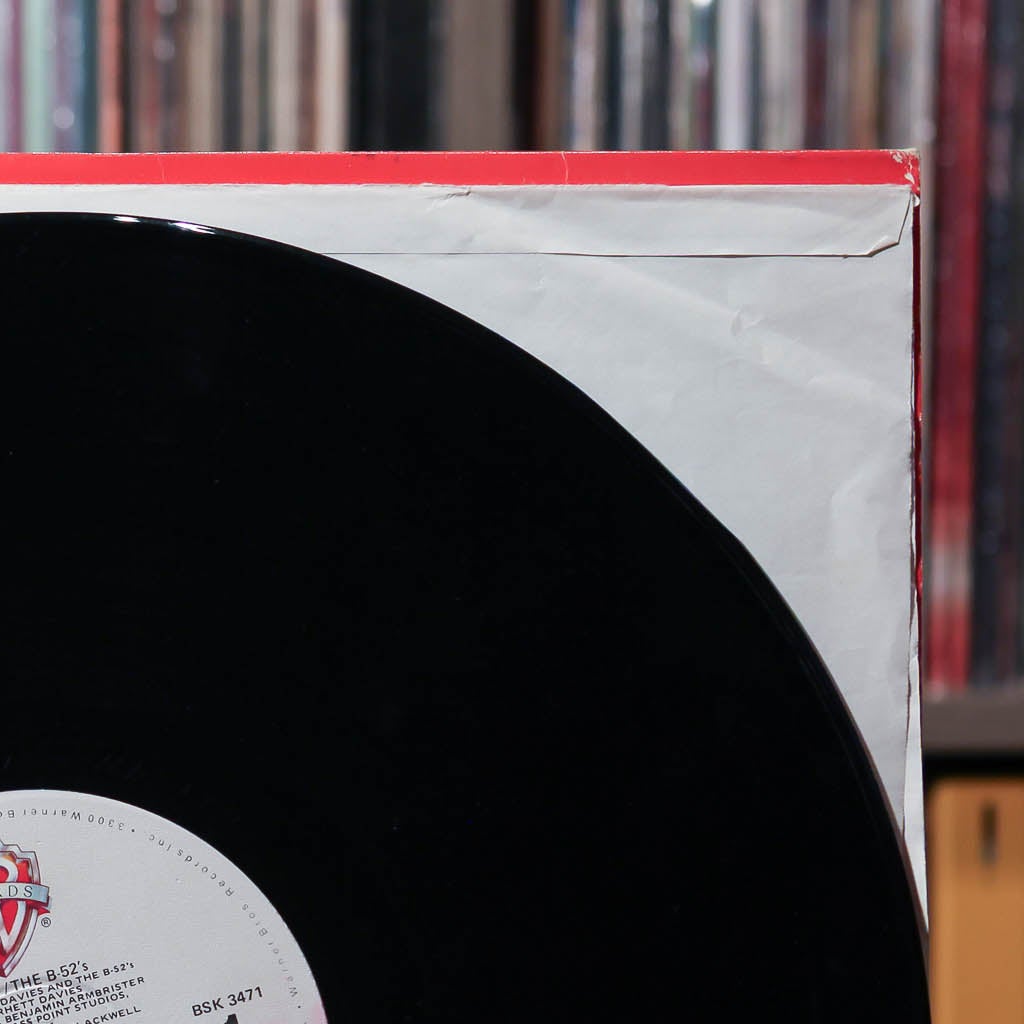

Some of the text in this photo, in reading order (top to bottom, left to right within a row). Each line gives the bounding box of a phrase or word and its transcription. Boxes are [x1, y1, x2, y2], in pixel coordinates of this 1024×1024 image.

[38, 984, 85, 1004] DAVIES
[45, 978, 75, 994] AND
[74, 970, 100, 985] THE
[2, 998, 66, 1024] BENJAMIN
[65, 976, 144, 1005] ARMBRISTER
[191, 986, 262, 1016] BSK 3471
[35, 1006, 72, 1024] POINT
